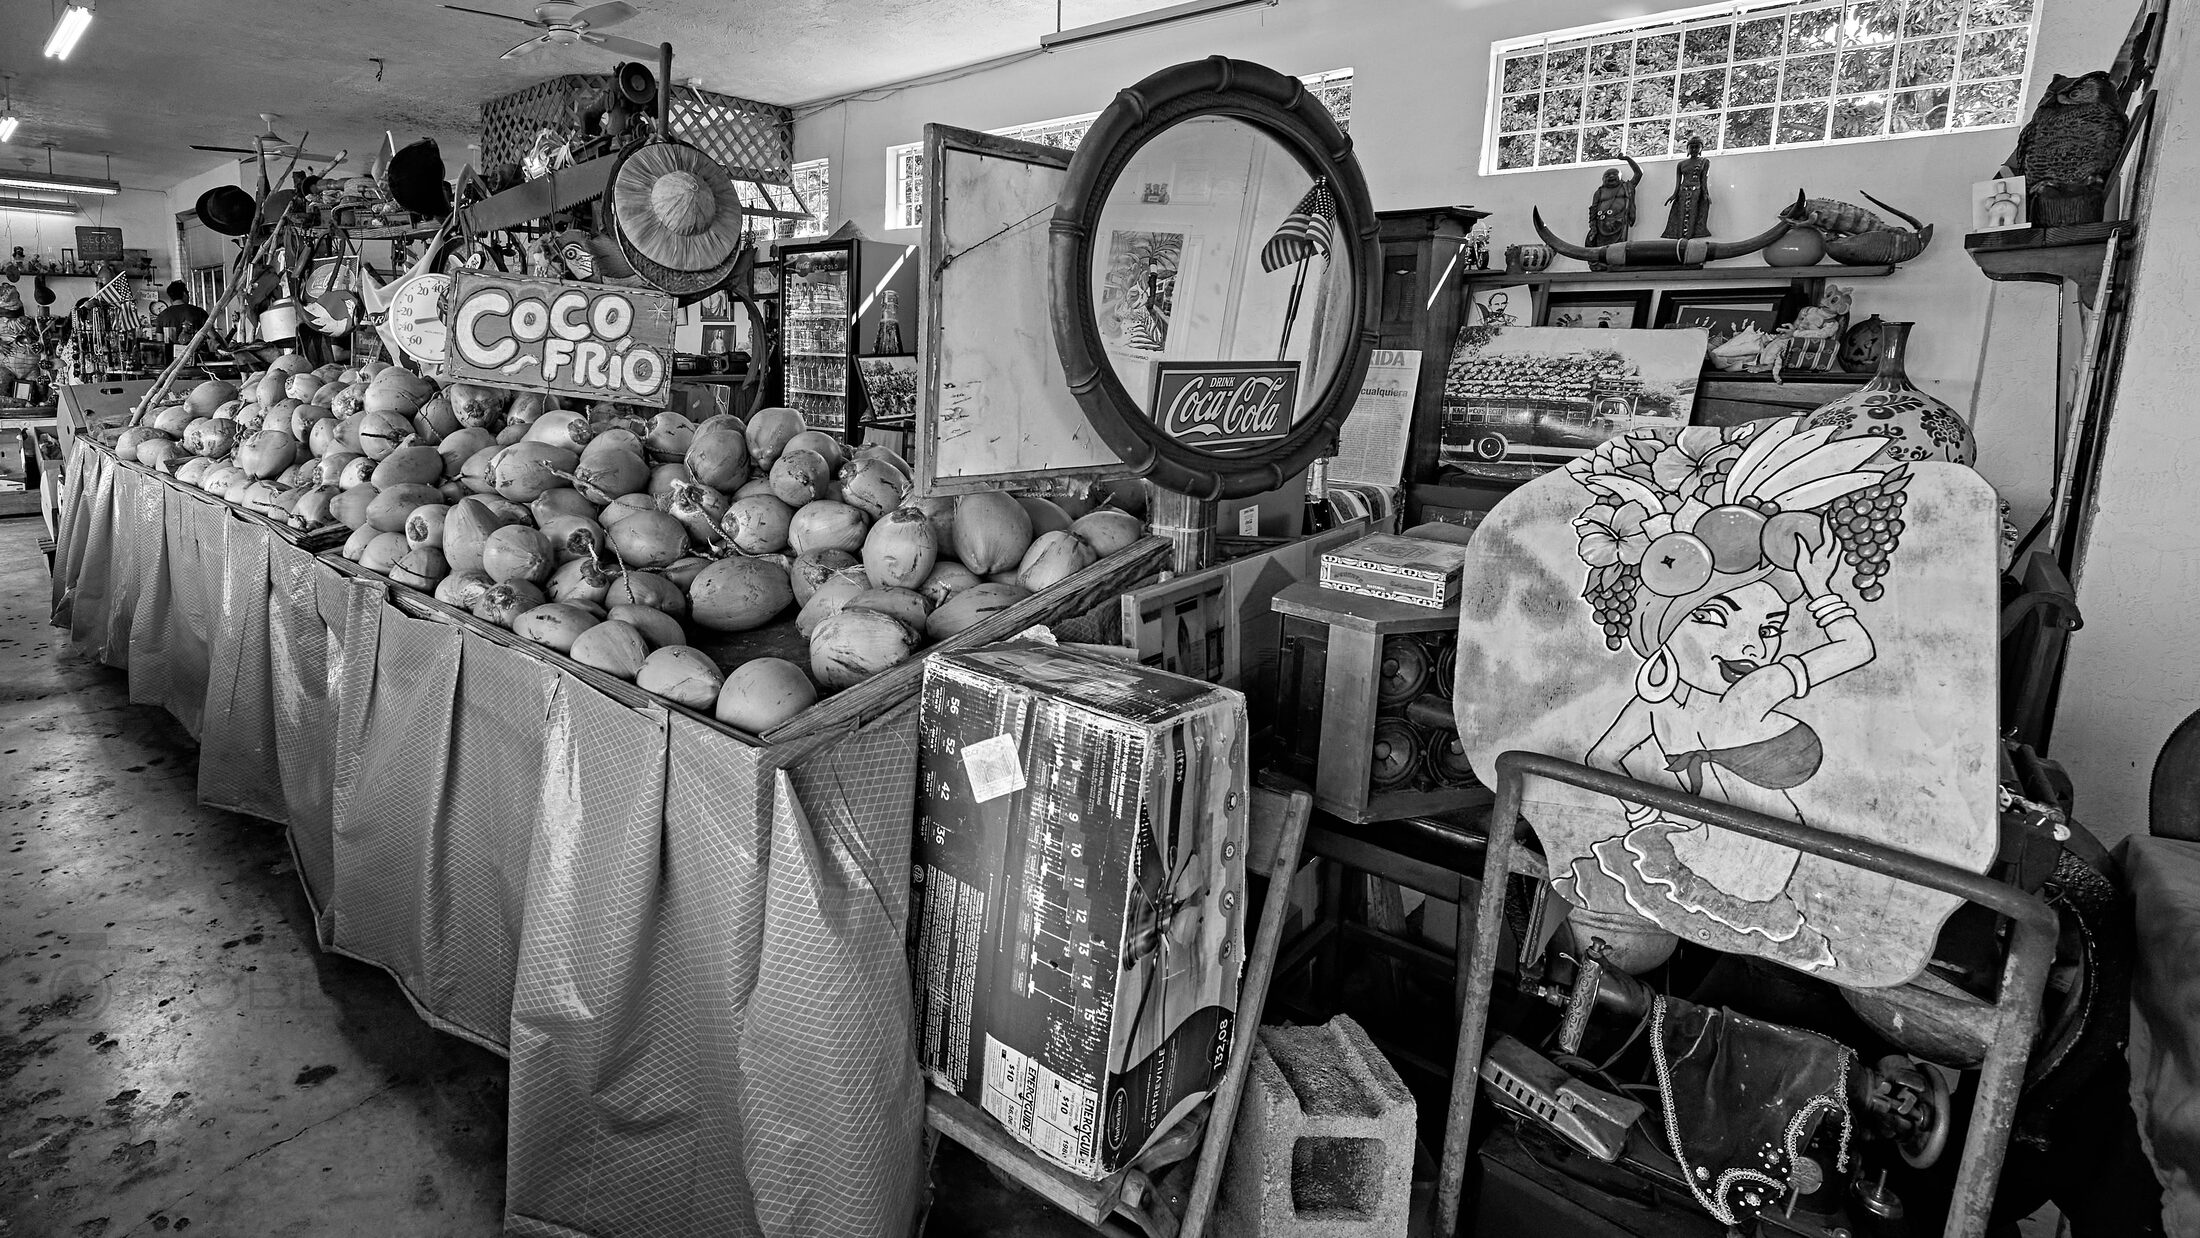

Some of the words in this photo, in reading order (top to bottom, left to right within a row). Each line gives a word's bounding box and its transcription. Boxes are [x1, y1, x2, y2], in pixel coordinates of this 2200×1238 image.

[407, 294, 413, 303] 0
[417, 286, 429, 296] 20
[455, 289, 634, 367] COCO
[542, 335, 665, 395] FRÍO
[1210, 377, 1236, 388] DRINK
[1360, 387, 1408, 400] cualquiera
[1165, 376, 1288, 438] Coca-Cola
[949, 697, 960, 715] 56
[945, 738, 955, 755] 52
[940, 782, 950, 801] 42
[1068, 812, 1079, 822] 9
[935, 827, 945, 845] 36
[1070, 843, 1082, 857] 10
[1073, 877, 1085, 889] 11
[1075, 909, 1088, 924] 12
[1078, 942, 1090, 957] 13
[1081, 974, 1093, 989] 14
[1213, 1018, 1228, 1070] 132,08
[1006, 1064, 1015, 1082] $10
[1149, 1048, 1166, 1129] CENTREVILLE
[1021, 1066, 1036, 1134] ENERGYGUIDE
[1060, 1096, 1070, 1115] $10
